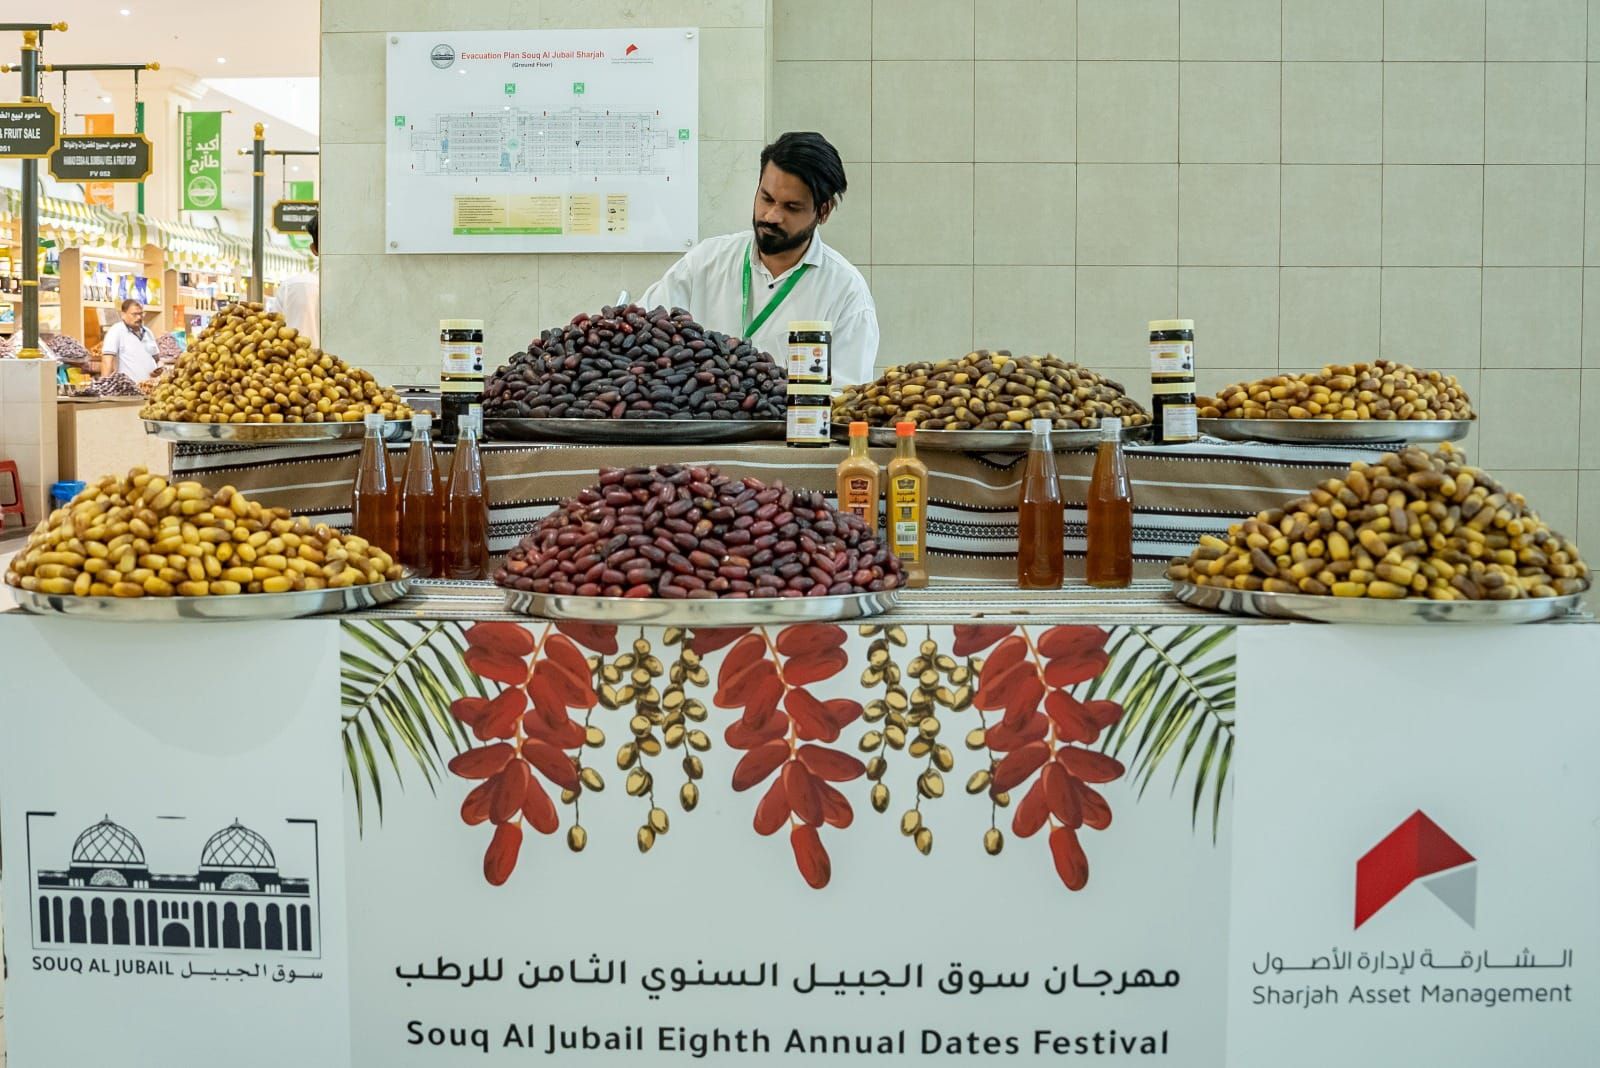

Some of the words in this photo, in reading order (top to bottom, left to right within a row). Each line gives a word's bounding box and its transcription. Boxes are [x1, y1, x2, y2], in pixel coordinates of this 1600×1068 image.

[461, 52, 502, 60] Evacuation
[503, 51, 519, 59] Plan
[522, 51, 540, 61] Souq
[543, 51, 550, 59] Al
[552, 50, 574, 59] Jubail
[576, 50, 604, 60] Sharjah
[4, 128, 23, 139] FRUIT
[24, 128, 41, 139] SALE
[189, 154, 220, 174] طازج
[33, 956, 82, 974] SOUQ
[89, 959, 110, 973] AL
[114, 960, 174, 976] JUBAIL
[181, 961, 267, 982] الجبيل
[395, 956, 504, 987] للرطب
[518, 953, 627, 989] الثامن
[1253, 947, 1351, 975] الأصول
[1358, 951, 1415, 974] لإدارة
[1420, 948, 1572, 972] الشارقة
[272, 964, 323, 983] سوق
[641, 960, 778, 1000] السنوي
[793, 962, 923, 996] الجبيل
[938, 962, 1029, 994] سوق
[1044, 964, 1180, 996] مهرجان
[1253, 985, 1338, 1008] Sharjah
[1349, 985, 1411, 1003] Asset
[1421, 984, 1572, 1007] Management
[407, 1021, 489, 1053] Souq
[503, 1024, 534, 1048] Al
[545, 1025, 643, 1055] Jubail
[658, 1027, 770, 1058] Eighth
[784, 1029, 904, 1055] Annual
[921, 1030, 1019, 1055] Dates
[1034, 1030, 1168, 1055] Festival
